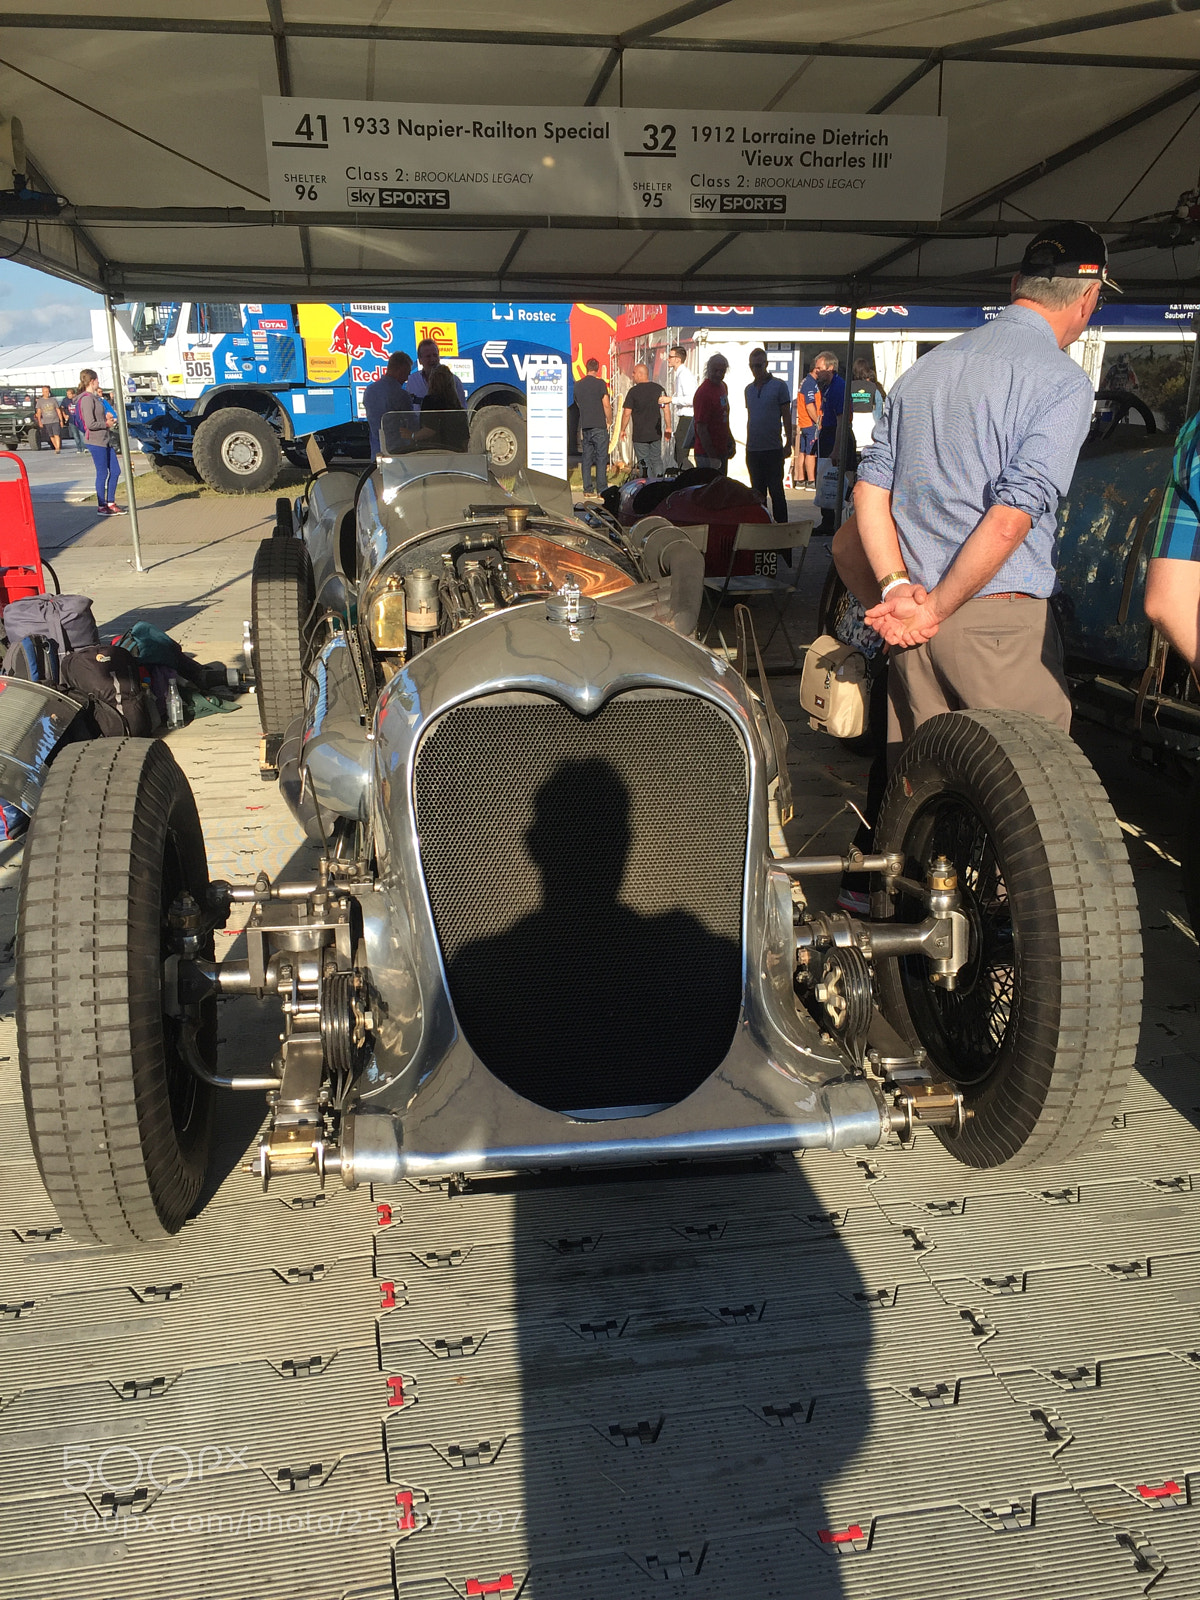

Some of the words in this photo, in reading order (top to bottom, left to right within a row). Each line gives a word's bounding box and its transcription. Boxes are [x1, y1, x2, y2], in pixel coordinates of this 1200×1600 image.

[295, 113, 329, 142] 41
[342, 116, 390, 136] 1933
[397, 118, 537, 142] Napier-Railton
[544, 121, 610, 143] Special
[642, 124, 677, 151] 32
[691, 126, 735, 143] 1912
[742, 127, 816, 145] Lorraine
[822, 128, 889, 146] Dietrich
[799, 151, 866, 168] Charles
[284, 173, 327, 184] SHELTER
[345, 166, 389, 182] Class
[395, 168, 410, 182] 2:
[414, 171, 489, 184] BROOKLANDS
[492, 172, 534, 184] LEGACY
[690, 174, 731, 188] Class
[736, 174, 750, 188] 2:
[755, 177, 824, 189] BROOKLANDS
[827, 178, 866, 189] LEGACY
[295, 184, 318, 201] 96
[633, 182, 672, 192] SHELTER
[350, 188, 375, 206] sky
[382, 191, 447, 206] SPORTS
[642, 192, 663, 208] 95
[693, 196, 717, 211] sky
[723, 197, 784, 211] SPORTS
[352, 304, 387, 312] LIEBHERR
[518, 309, 557, 322] Rostec
[1164, 311, 1187, 319] Sauber
[186, 362, 212, 377] 505
[352, 366, 380, 382] Red
[754, 552, 777, 564] EKG
[754, 564, 777, 576] 505
